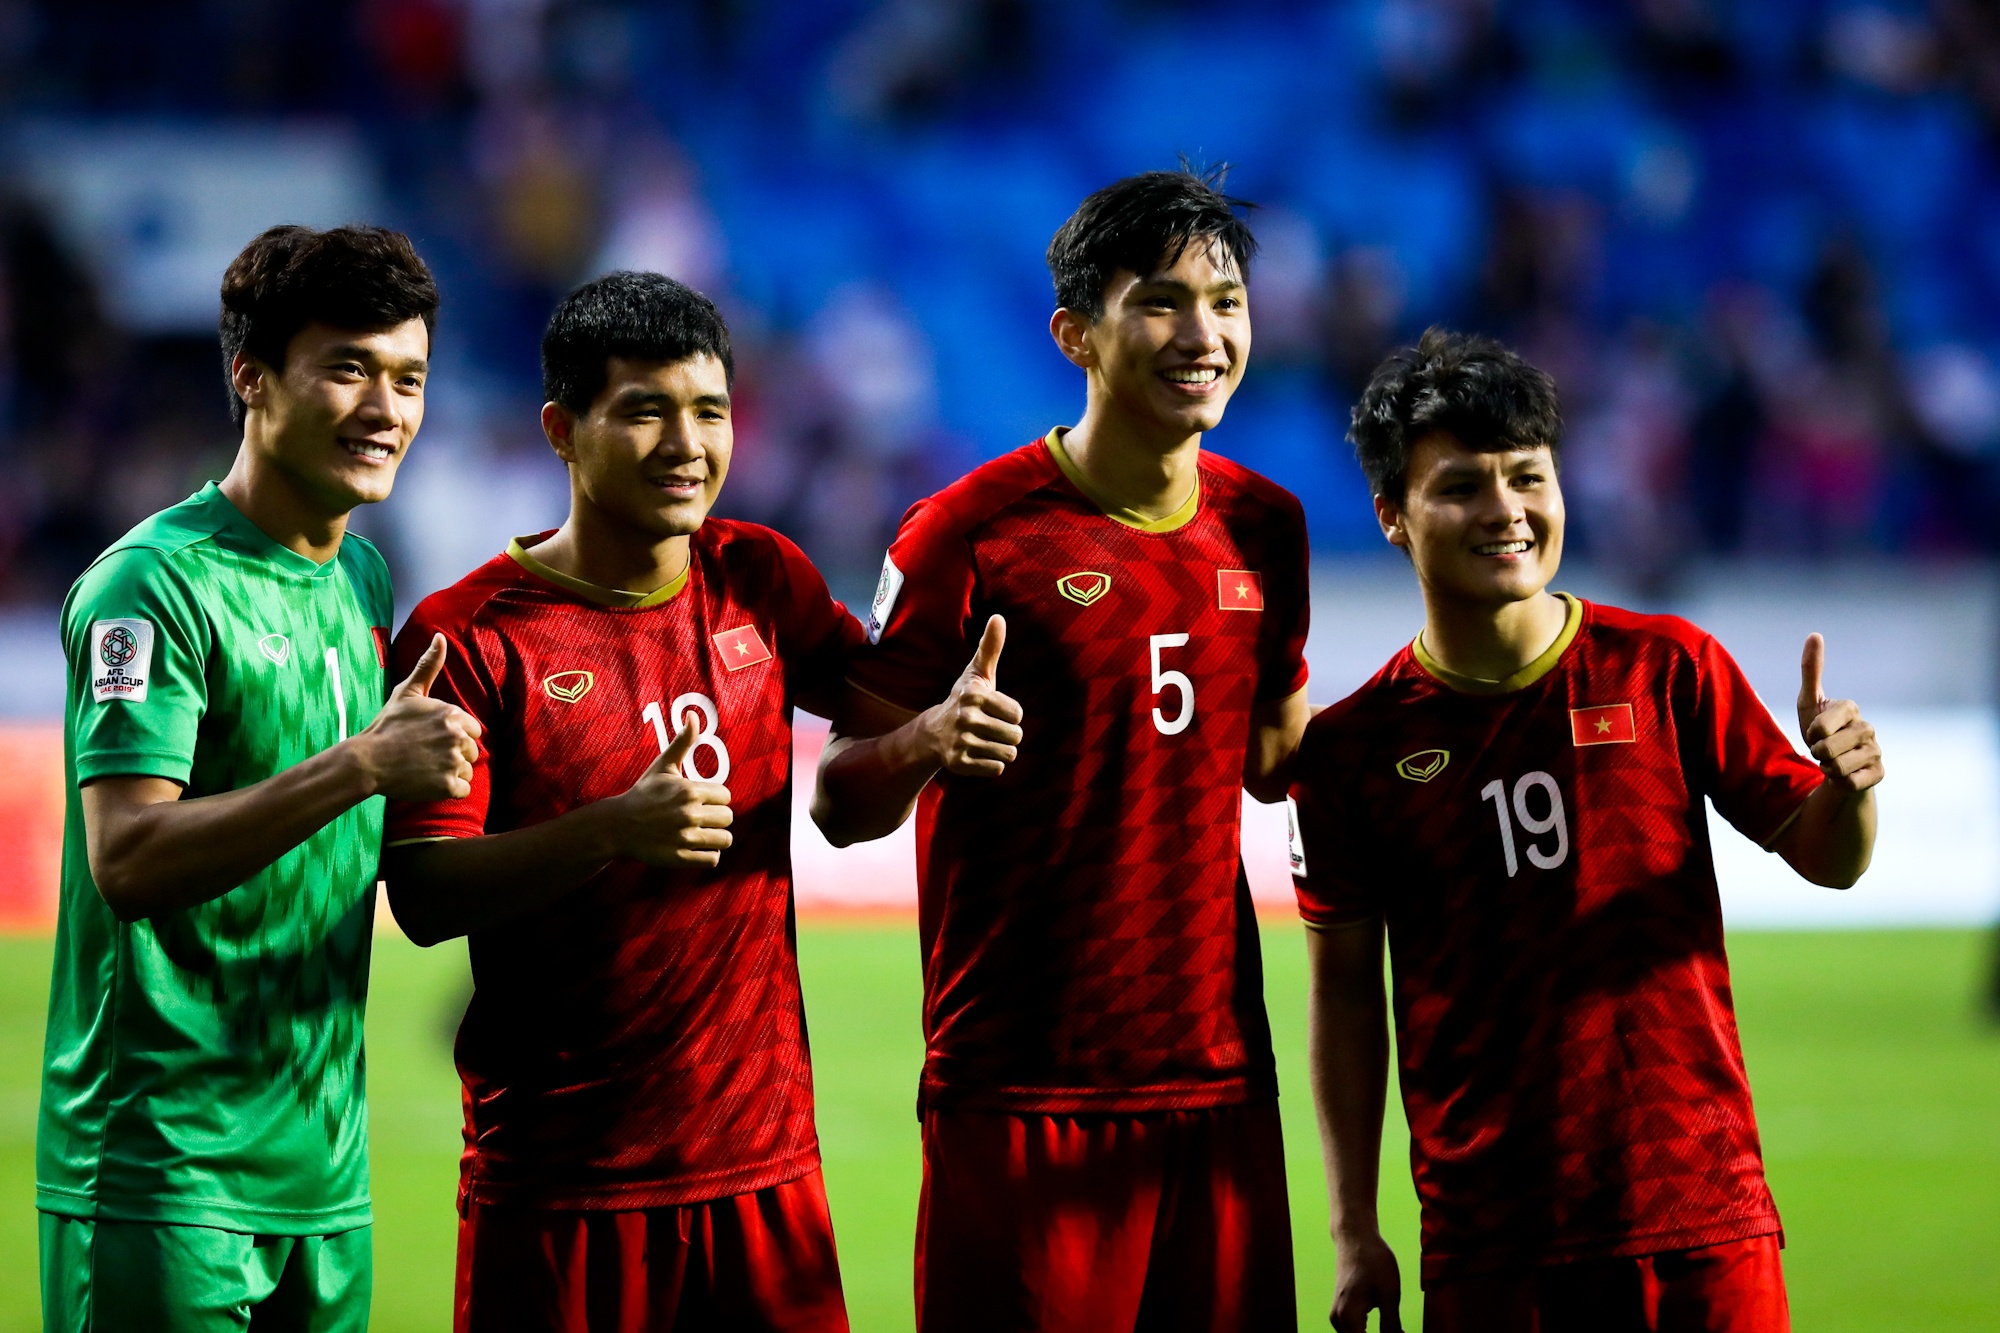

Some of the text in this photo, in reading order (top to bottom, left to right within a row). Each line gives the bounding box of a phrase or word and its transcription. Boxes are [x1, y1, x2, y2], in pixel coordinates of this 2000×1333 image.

[94, 676, 144, 688] ASIAN CUP
[107, 668, 124, 676] AFC
[113, 685, 132, 693] 2019
[325, 646, 348, 743] 1
[1149, 632, 1195, 735] 5
[642, 692, 730, 785] 18
[1481, 770, 1569, 878] 19
